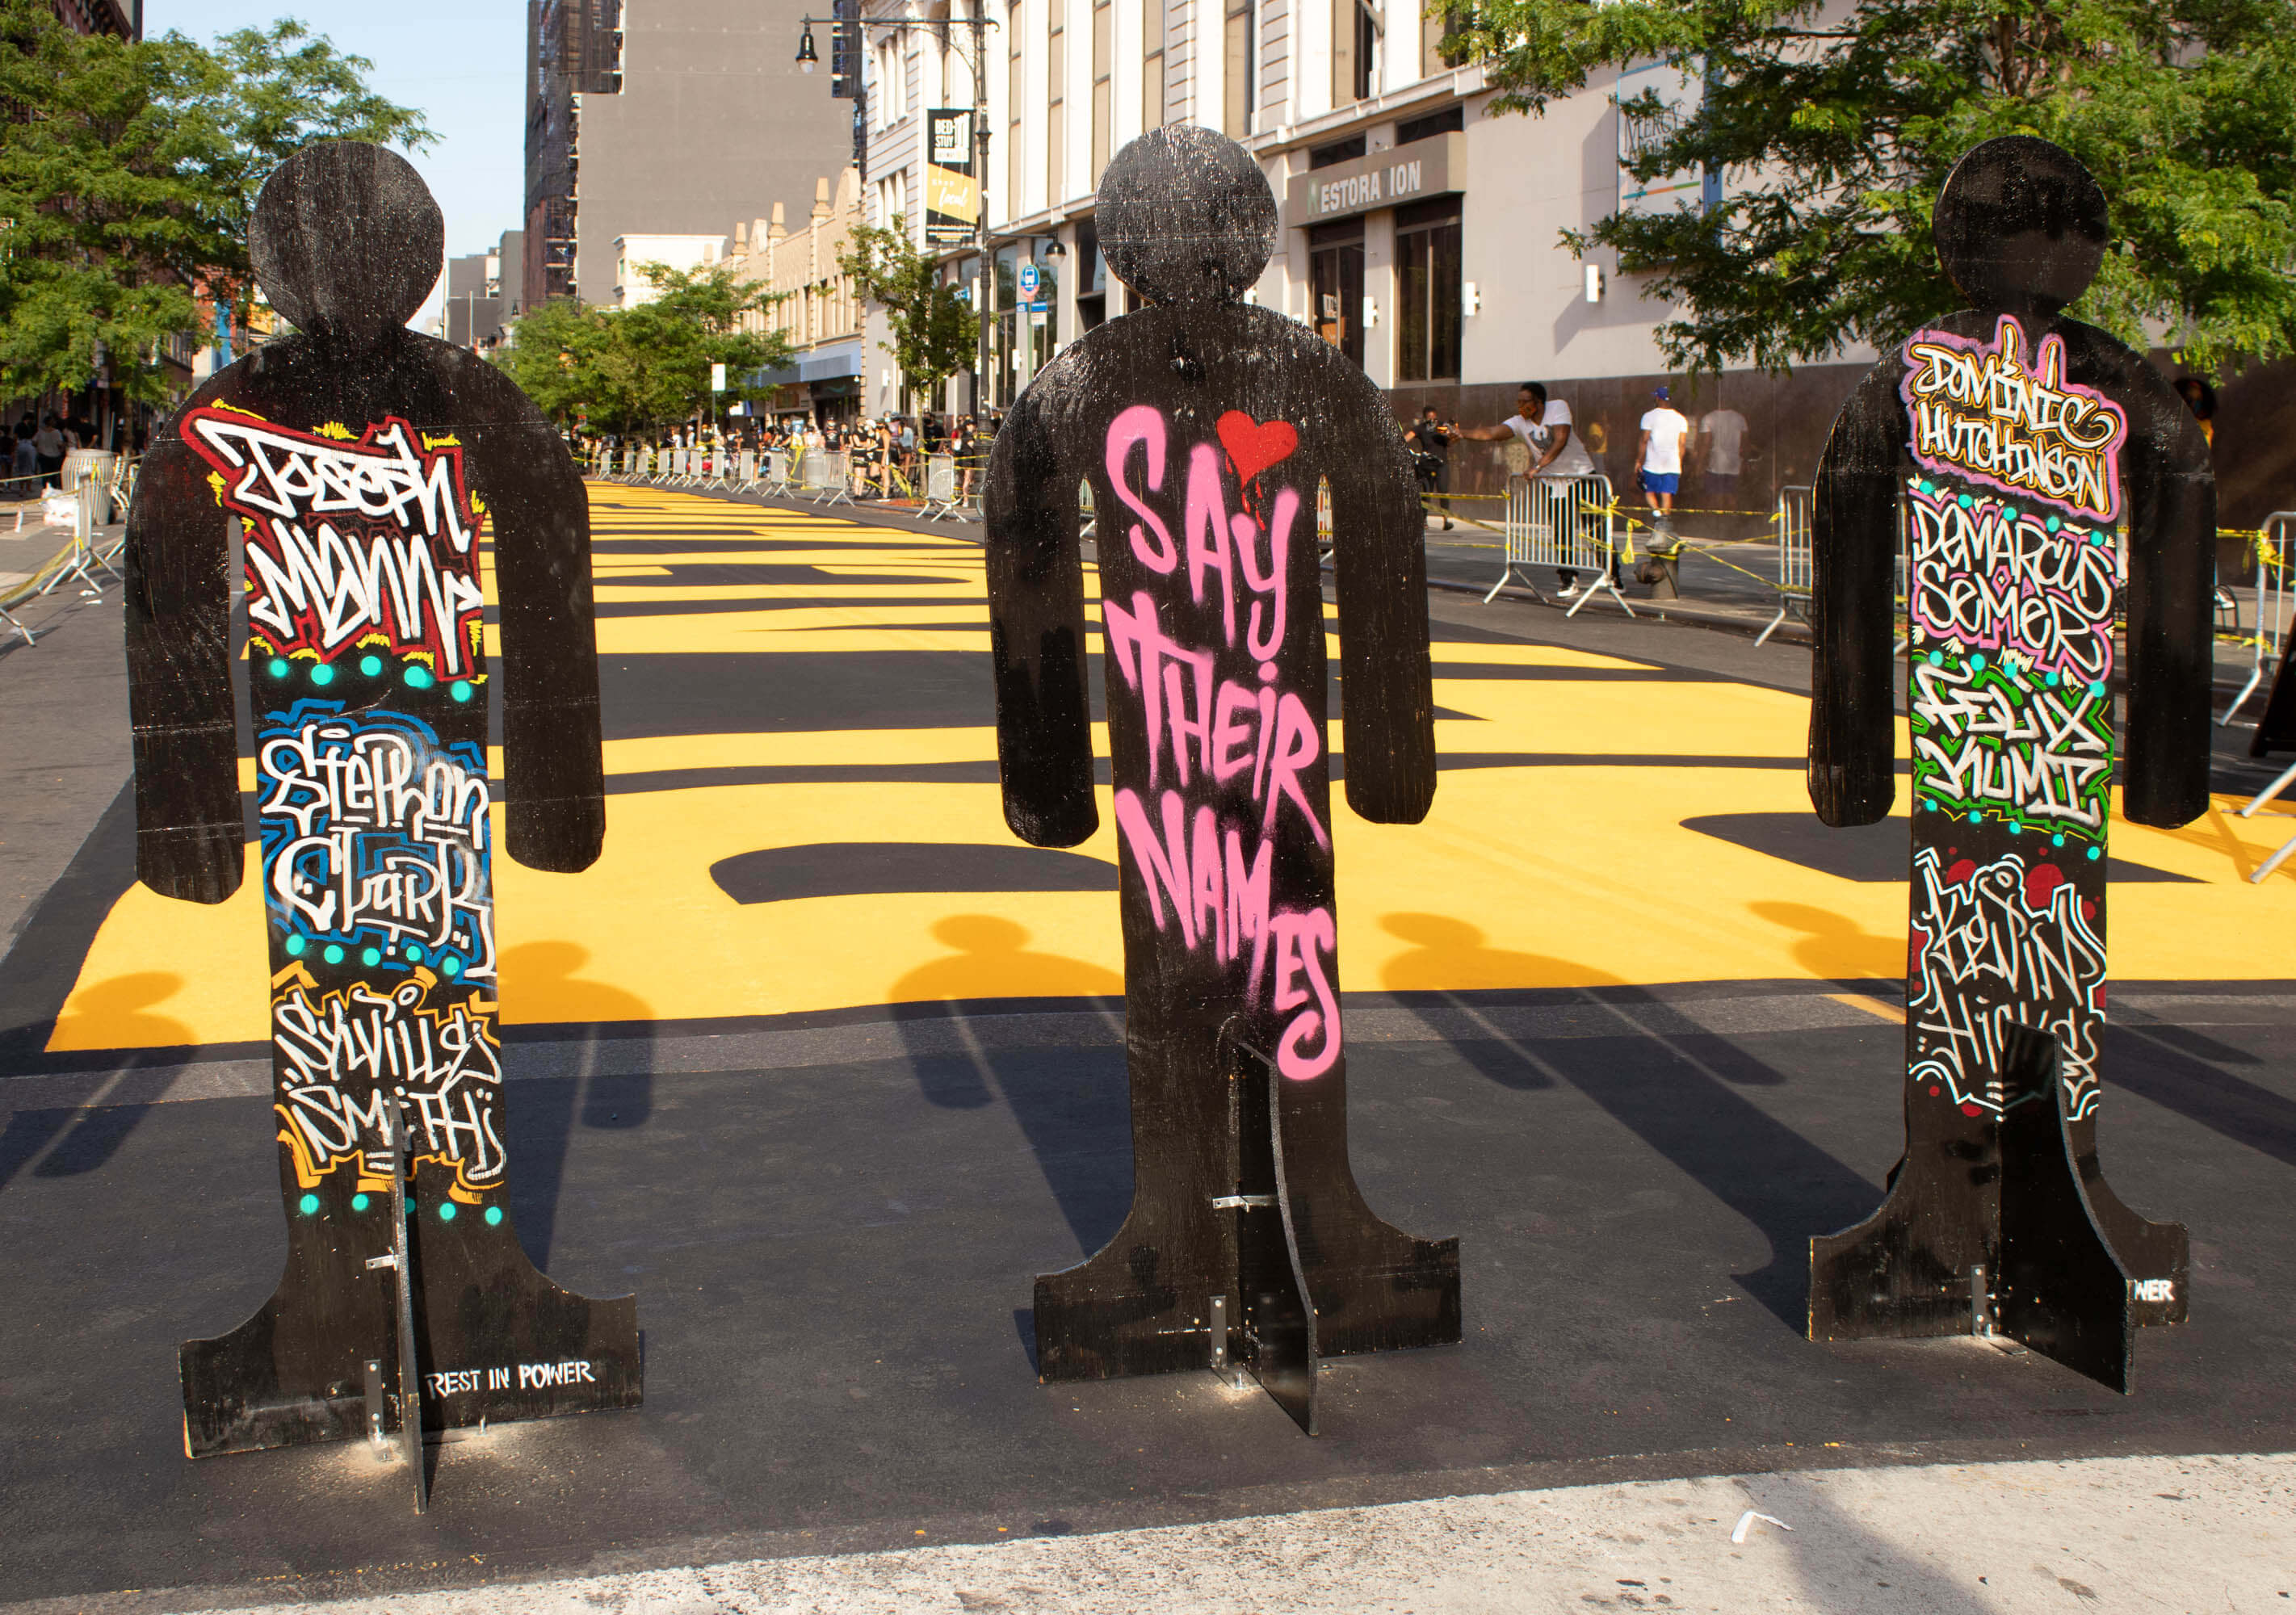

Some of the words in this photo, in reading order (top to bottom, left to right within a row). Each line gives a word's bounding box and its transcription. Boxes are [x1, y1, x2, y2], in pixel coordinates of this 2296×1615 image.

[935, 135, 954, 148] STUY
[1106, 405, 1299, 661] SAY
[1103, 590, 1332, 852] THEIR
[1114, 787, 1342, 1081] NAMES
[425, 1370, 481, 1399] REST
[488, 1367, 510, 1390] IN
[518, 1361, 596, 1389] POWER
